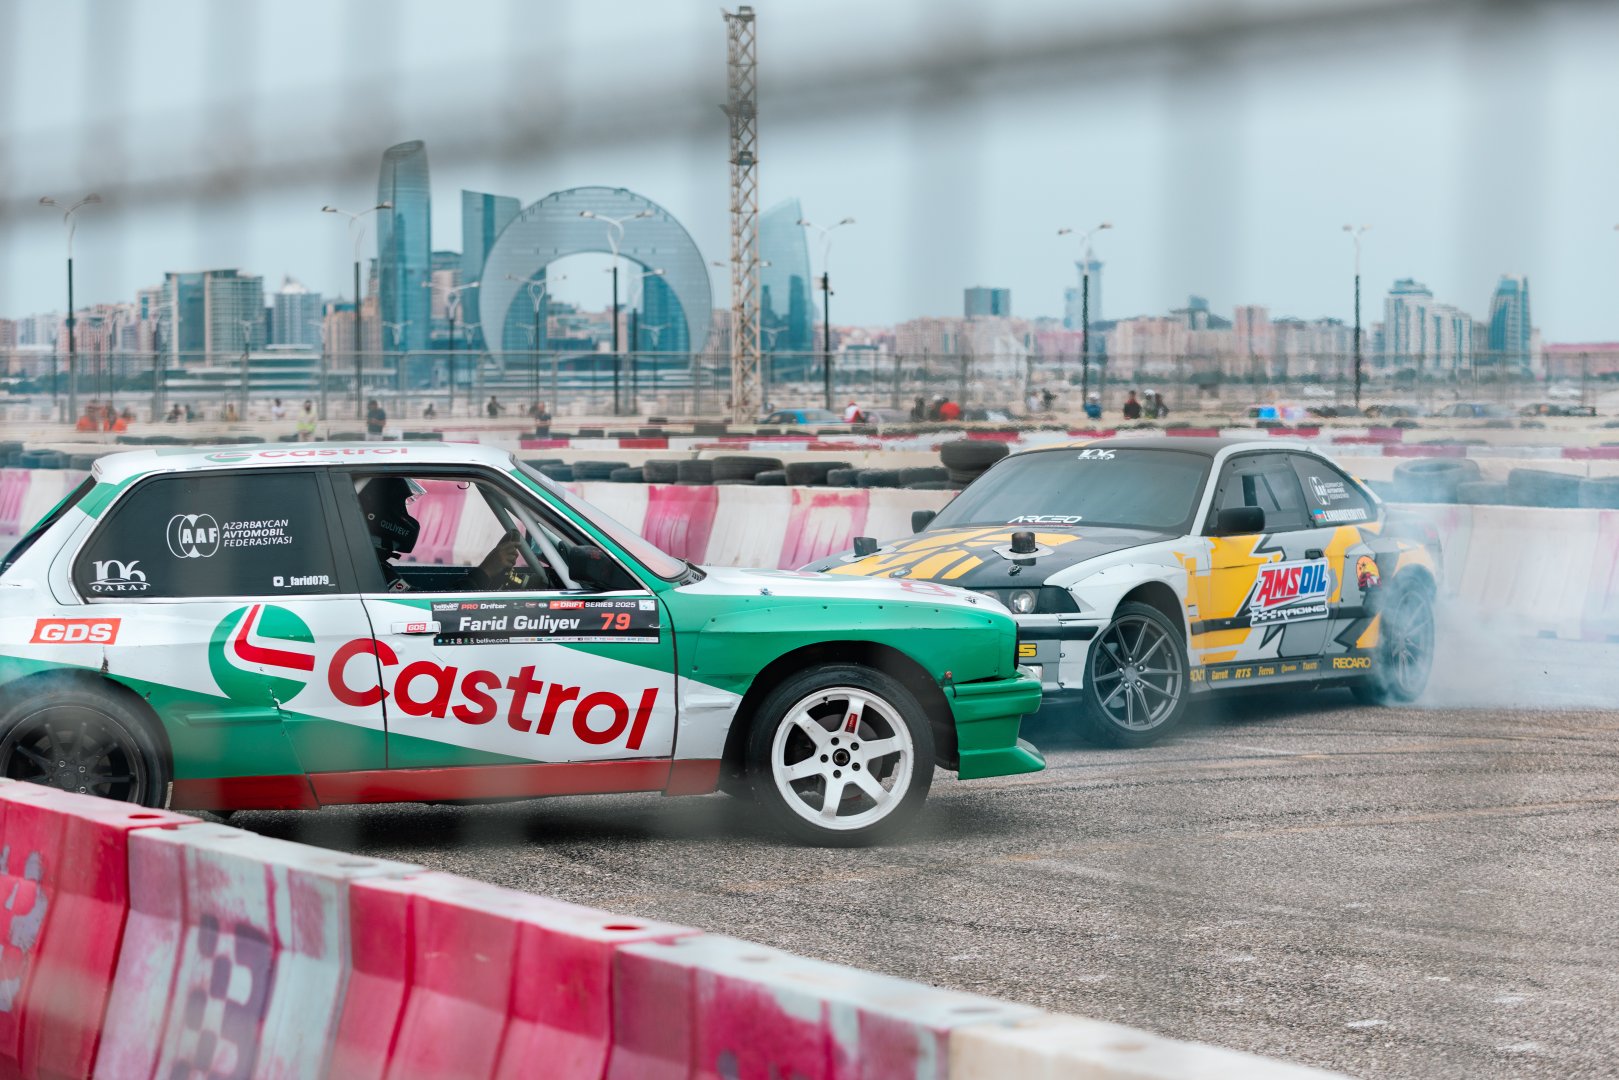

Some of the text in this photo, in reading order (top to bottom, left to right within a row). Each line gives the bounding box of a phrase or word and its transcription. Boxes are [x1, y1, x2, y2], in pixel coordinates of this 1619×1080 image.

[258, 447, 408, 459] Castrol
[182, 527, 217, 544] AAF
[222, 528, 285, 539] AVTOMOBIL
[92, 560, 146, 581] 106
[92, 584, 147, 592] QARAJ
[1256, 564, 1327, 607] AMSOIL
[480, 602, 507, 610] Drifter
[615, 600, 636, 608] 2025
[1277, 604, 1325, 620] RACING
[459, 615, 580, 633] Farid Guliyev
[600, 613, 631, 630] 79
[39, 623, 112, 643] GDS
[1332, 657, 1371, 669] RECARO
[1235, 668, 1252, 679] RTS
[328, 638, 659, 750] Castrol
